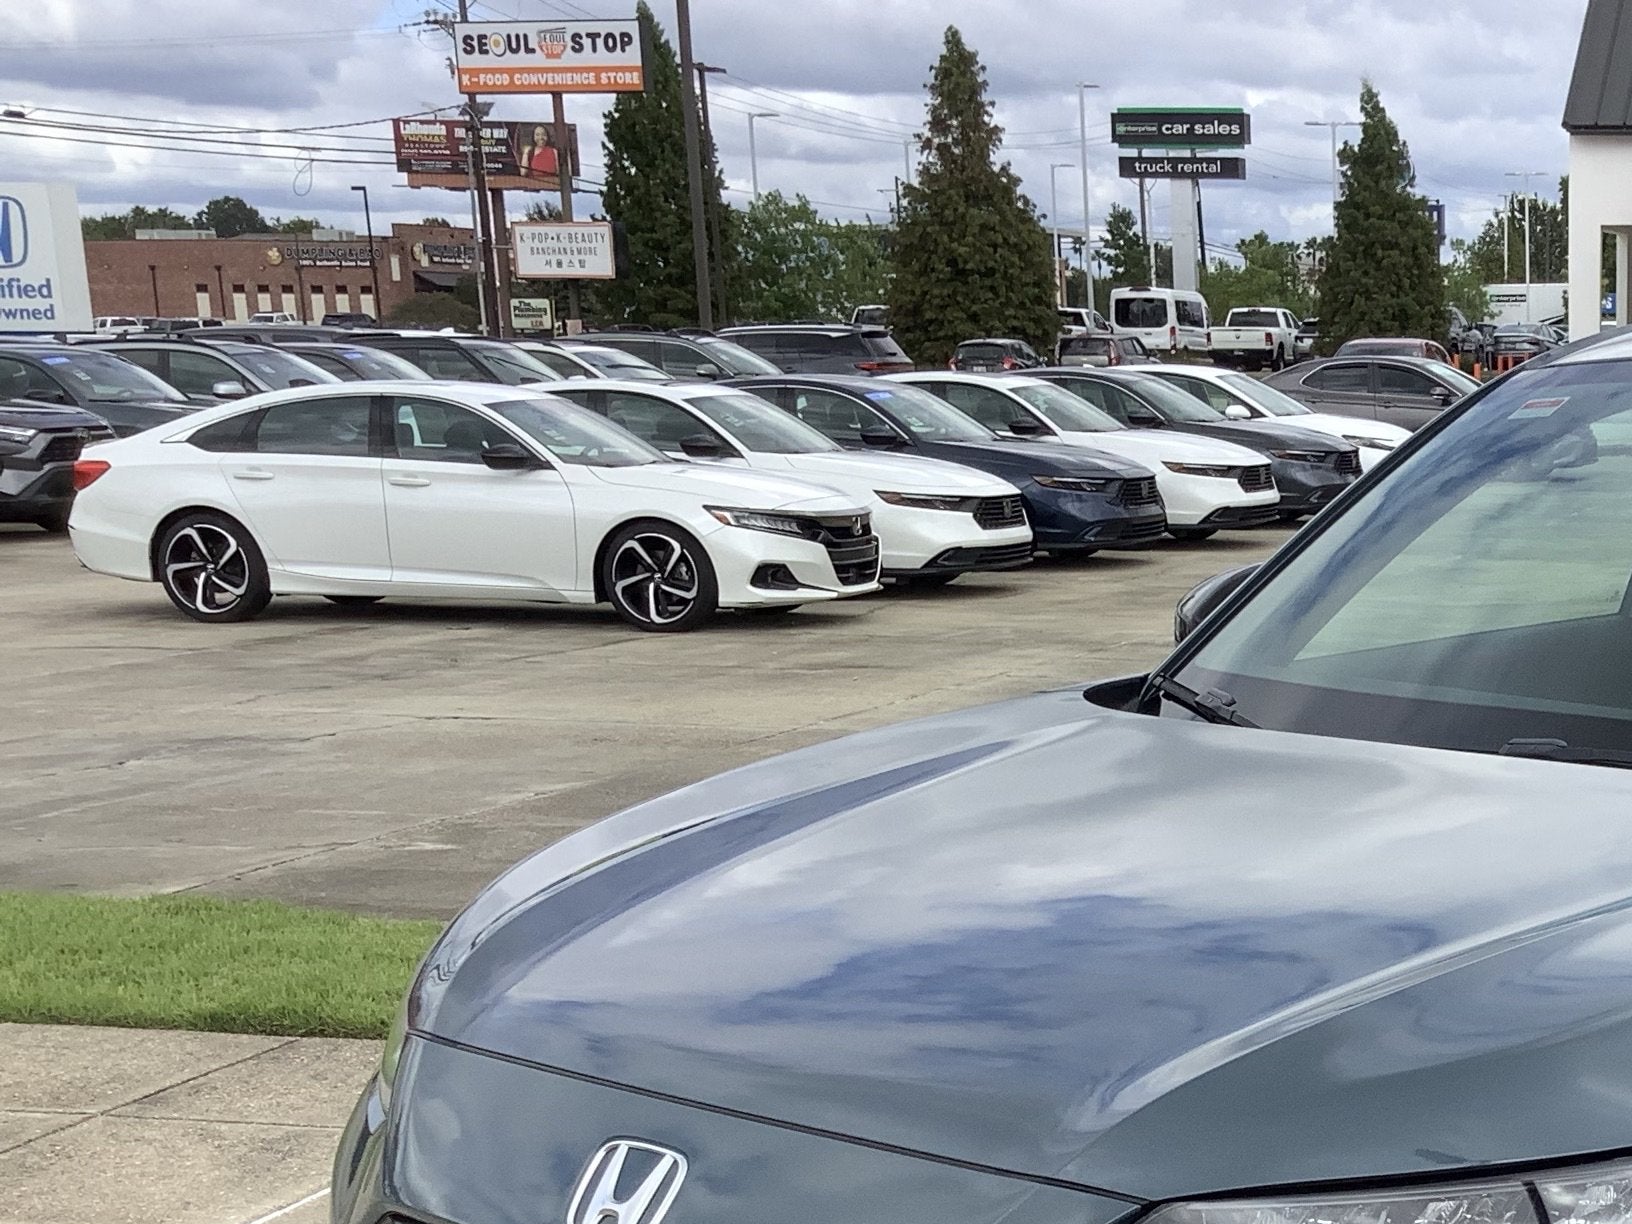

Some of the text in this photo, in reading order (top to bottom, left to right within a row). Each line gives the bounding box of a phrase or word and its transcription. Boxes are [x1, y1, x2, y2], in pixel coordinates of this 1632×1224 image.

[462, 32, 633, 57] SEOUL STOP
[462, 72, 640, 86] K-FOOD CONVENIENCE STORE
[1162, 122, 1191, 135] car
[1194, 120, 1241, 135] sales
[1134, 160, 1221, 173] truck rental
[0, 303, 55, 320] wned
